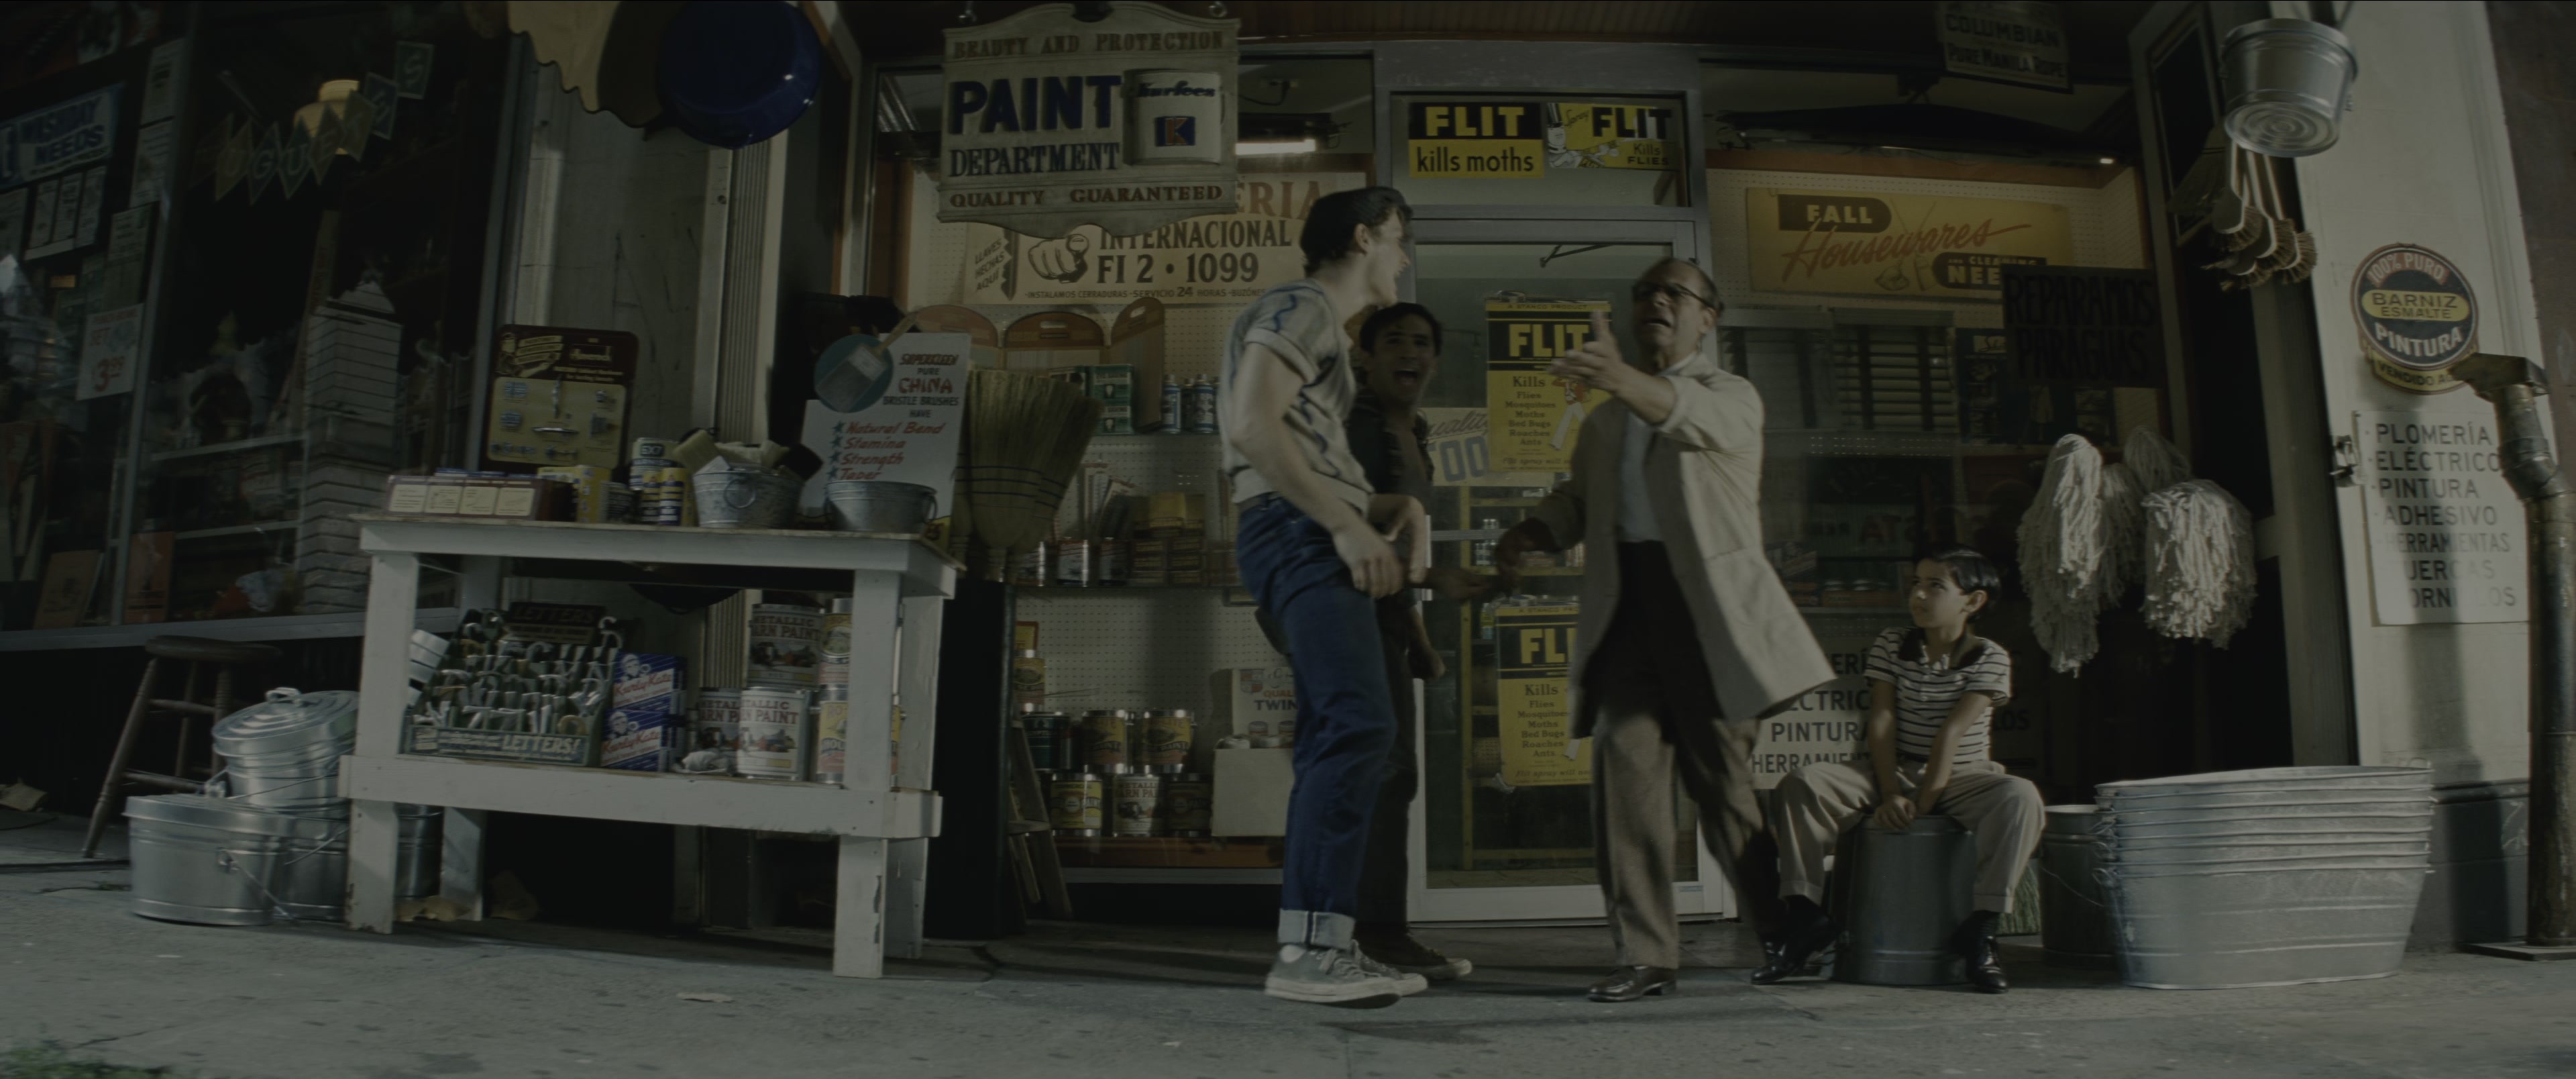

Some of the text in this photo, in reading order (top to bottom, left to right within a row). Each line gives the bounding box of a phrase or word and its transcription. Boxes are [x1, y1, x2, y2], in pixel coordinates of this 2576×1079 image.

[953, 31, 1224, 59] BEAUTY AND PROTECTION
[949, 75, 1122, 135] PAINT
[1424, 106, 1525, 137] FLIT
[1592, 107, 1672, 140] FLIT
[1165, 117, 1188, 146] K
[35, 124, 105, 164] NEEDS
[1633, 143, 1661, 156] Kills
[949, 143, 1120, 177] DEPARTMENT
[1417, 146, 1534, 172] kills moths
[1627, 156, 1669, 166] FLIES
[949, 185, 1223, 207] QUALITY GUARANTEED
[1807, 204, 1873, 224] FALL
[1782, 216, 2031, 282] Housewares
[1096, 252, 1259, 283] FI 2 1099
[1947, 265, 2000, 286] NEE
[2367, 252, 2445, 282] 100% PURO
[1077, 289, 1128, 299] CERRADURAS
[1177, 287, 1193, 297] 24
[1197, 289, 1226, 297] HORAS
[2373, 292, 2458, 309] BARNIZ
[2381, 306, 2452, 319] ESMALTE
[1509, 323, 1590, 358] FLIT
[2375, 321, 2464, 357] PINTURA
[916, 367, 940, 375] PURE
[2379, 361, 2435, 386] VENDIDO
[898, 377, 953, 394] CHINA
[1512, 376, 1546, 388] Kills
[883, 396, 960, 406] BRISTLE BRUSHES
[1505, 401, 1556, 410] Mosquitoes
[909, 409, 931, 417] HAVE
[847, 421, 947, 434] Natural Bend
[1426, 410, 1488, 437] ualit
[1508, 419, 1527, 427] Bed
[844, 436, 907, 450] Stamina
[2376, 421, 2493, 446] PLOMERÍA
[841, 452, 904, 471] Strength
[2375, 447, 2501, 472] ELÉCTRICO
[840, 468, 881, 480] Taper
[2379, 478, 2480, 499] PINTURA
[2383, 505, 2498, 525] ADHESIVO
[2385, 532, 2510, 553] HERRAMIENTAS
[2404, 559, 2496, 580] UERCAS
[2410, 586, 2517, 609] ORNIOS
[513, 606, 595, 625] LETTERS
[1519, 627, 1577, 664] FLI
[1263, 689, 1294, 698] QUAL
[1524, 684, 1558, 696] Kills
[700, 700, 739, 710] METAL
[742, 700, 790, 710] TALLIC
[1254, 699, 1299, 711] TWIN
[1529, 701, 1554, 709] Flies
[756, 709, 799, 724] PAINT
[1527, 720, 1558, 728] Moths
[502, 733, 581, 754] LETTERS!
[1521, 730, 1565, 739] Bed Bugs
[1522, 740, 1564, 748] Roaches
